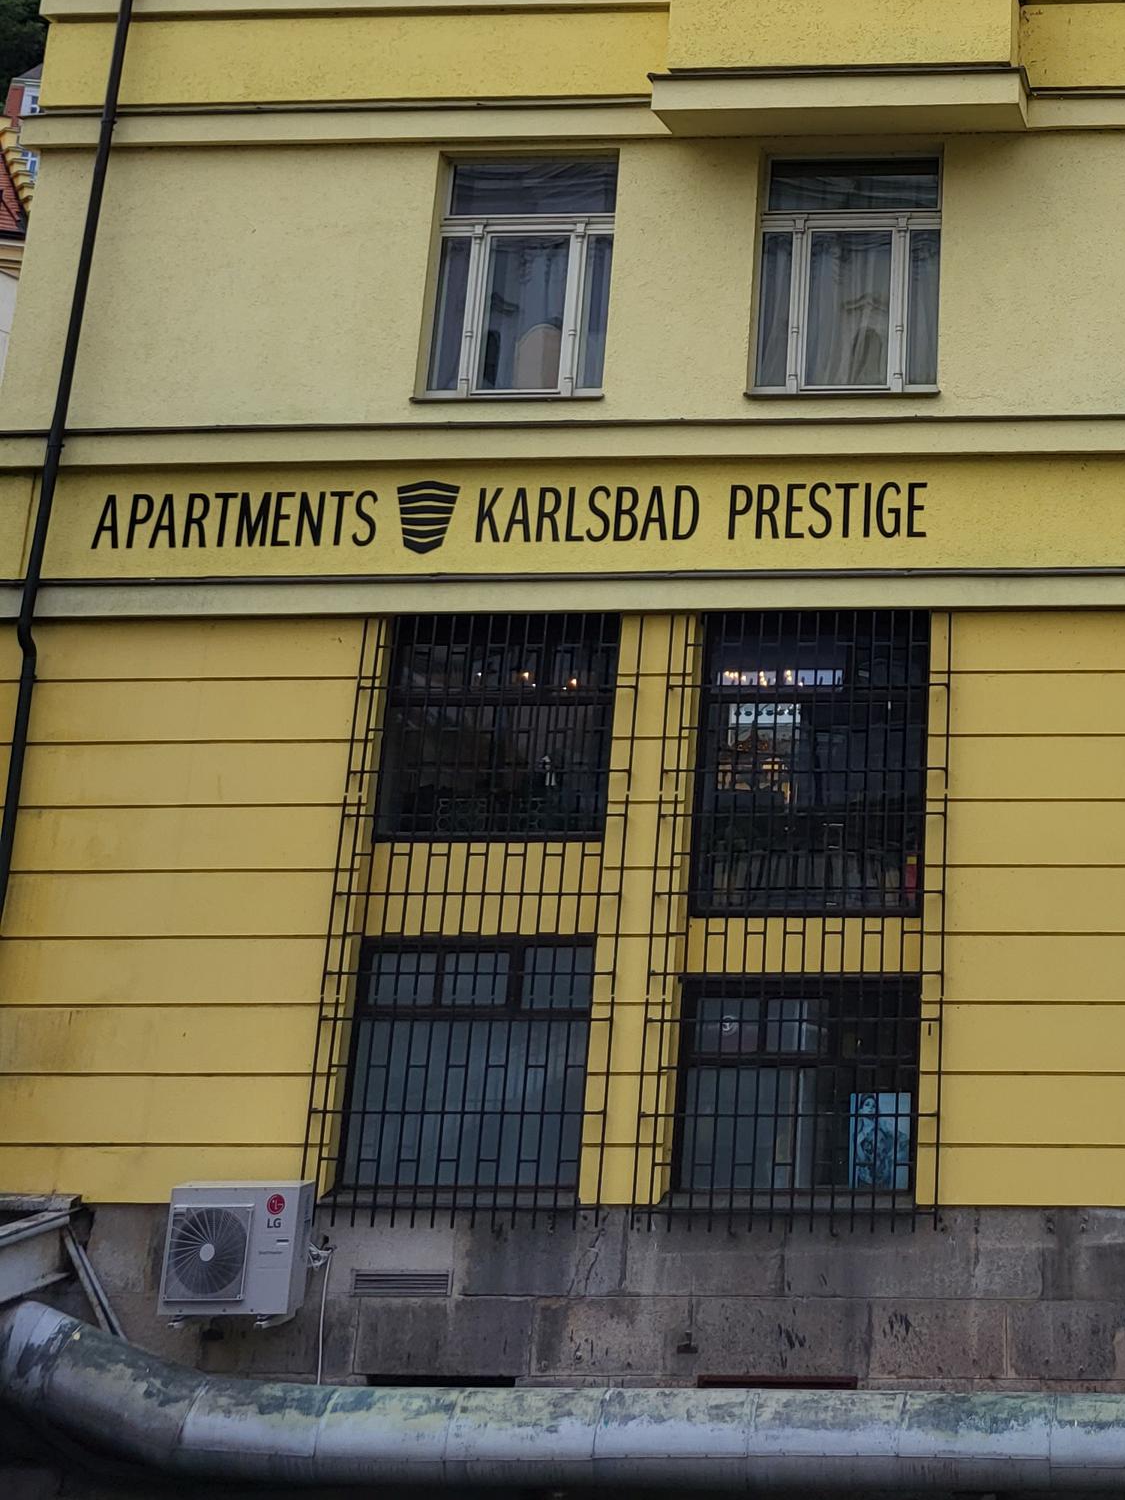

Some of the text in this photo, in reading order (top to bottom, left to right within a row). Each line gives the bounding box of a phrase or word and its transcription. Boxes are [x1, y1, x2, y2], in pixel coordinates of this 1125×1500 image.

[90, 481, 928, 550] APARTMENTS KARLSBAD PRESTIGE
[266, 1217, 282, 1229] LG
